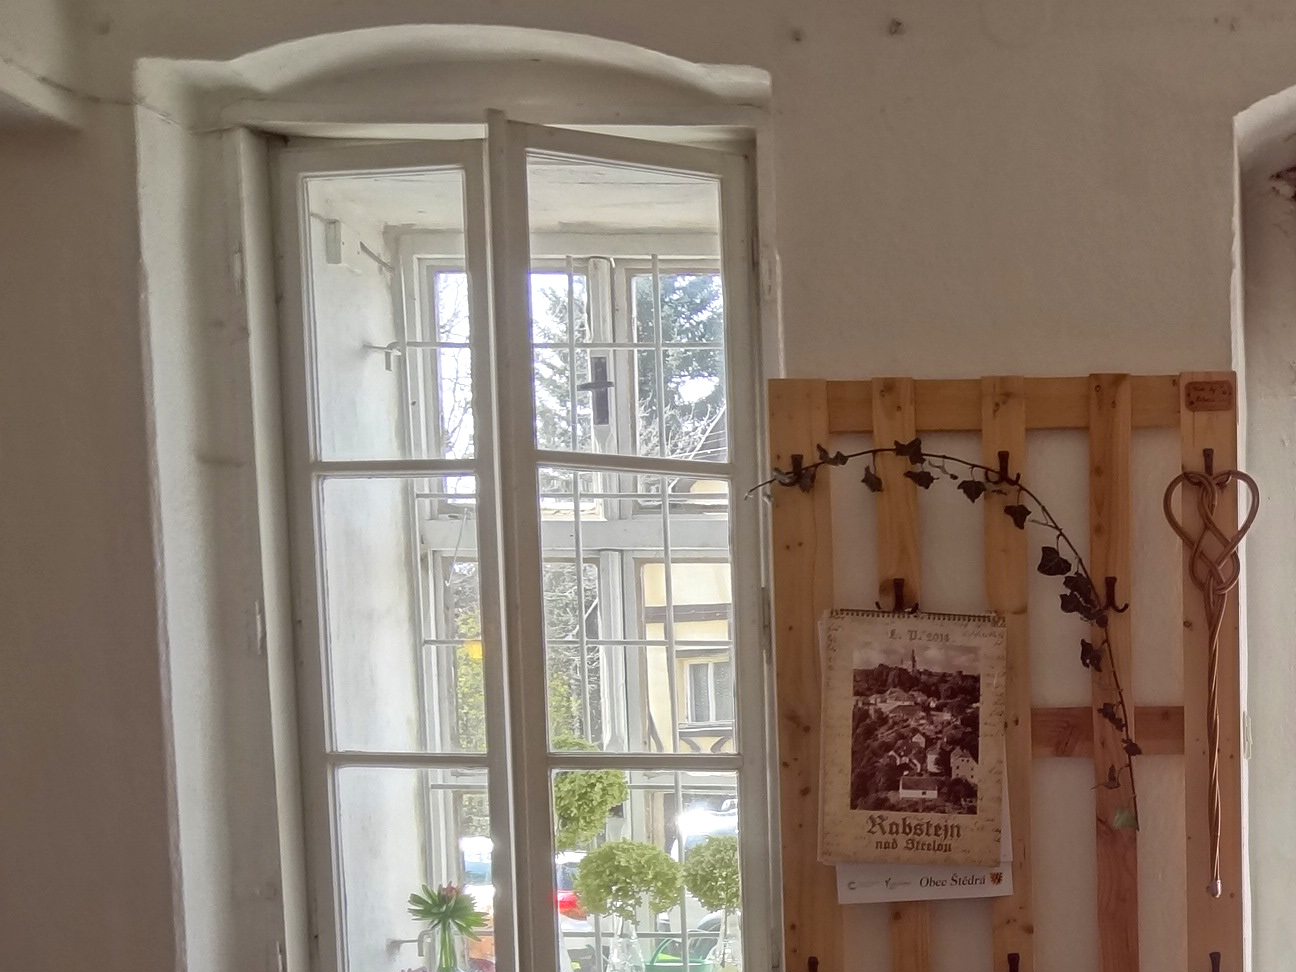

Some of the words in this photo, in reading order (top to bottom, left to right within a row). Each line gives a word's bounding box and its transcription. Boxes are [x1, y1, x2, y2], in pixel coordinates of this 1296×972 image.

[876, 839, 898, 850] nad
[919, 876, 947, 888] Obec
[951, 873, 986, 887] Štědrá
